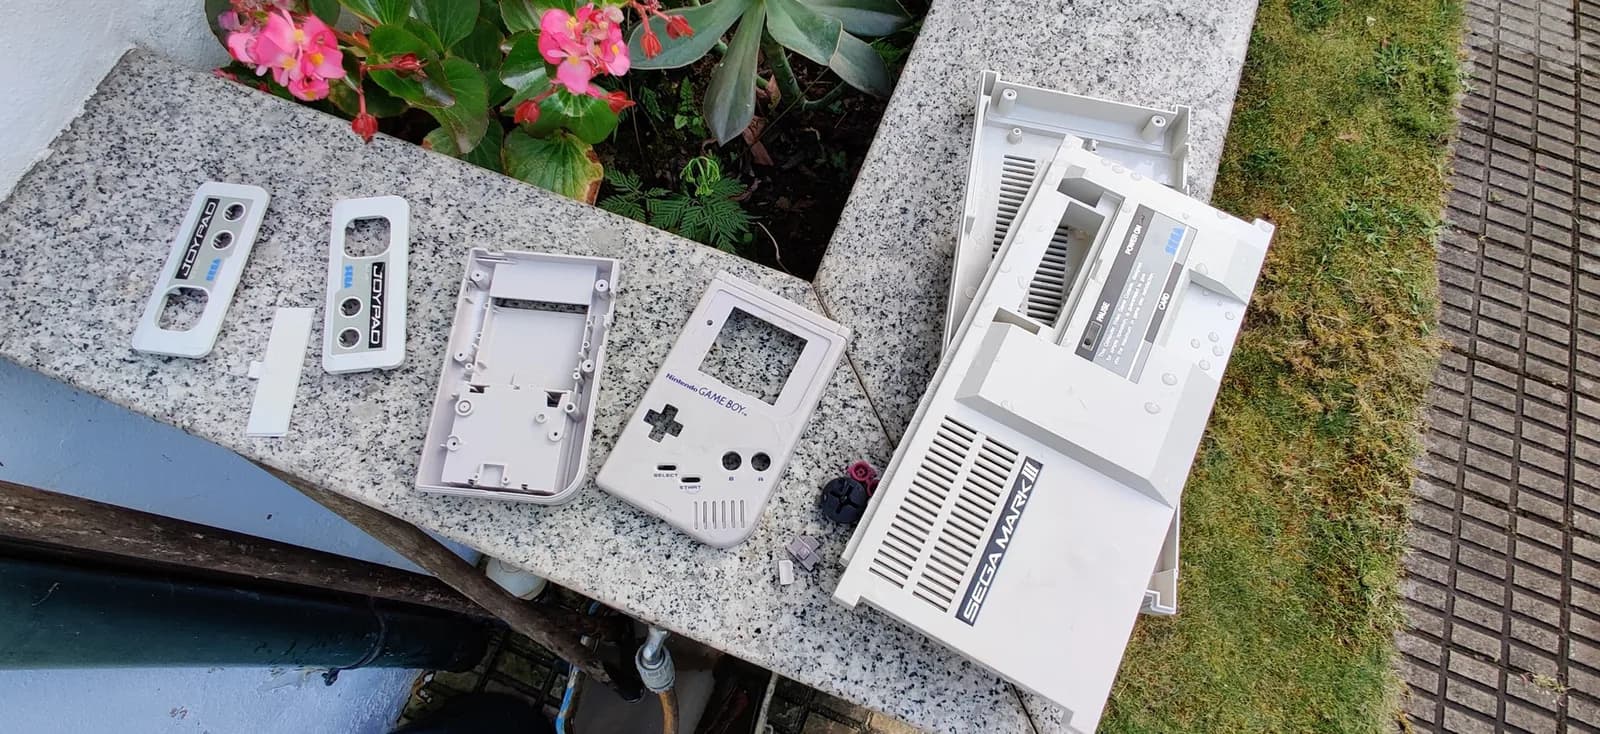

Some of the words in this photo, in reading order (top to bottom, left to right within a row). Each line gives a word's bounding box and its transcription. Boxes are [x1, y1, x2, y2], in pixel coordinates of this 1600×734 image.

[181, 202, 216, 277] JOYPAD
[1125, 233, 1139, 255] POWER
[1133, 224, 1143, 235] ON
[370, 265, 383, 345] JOYPAD
[1096, 301, 1111, 322] PAUSE
[1158, 292, 1170, 311] CARD
[665, 373, 698, 392] Nintendo
[698, 387, 727, 406] GAME
[725, 399, 746, 414] BOY
[963, 552, 1002, 623] SEGA
[995, 483, 1033, 549] MARK
[1021, 461, 1040, 484] III
